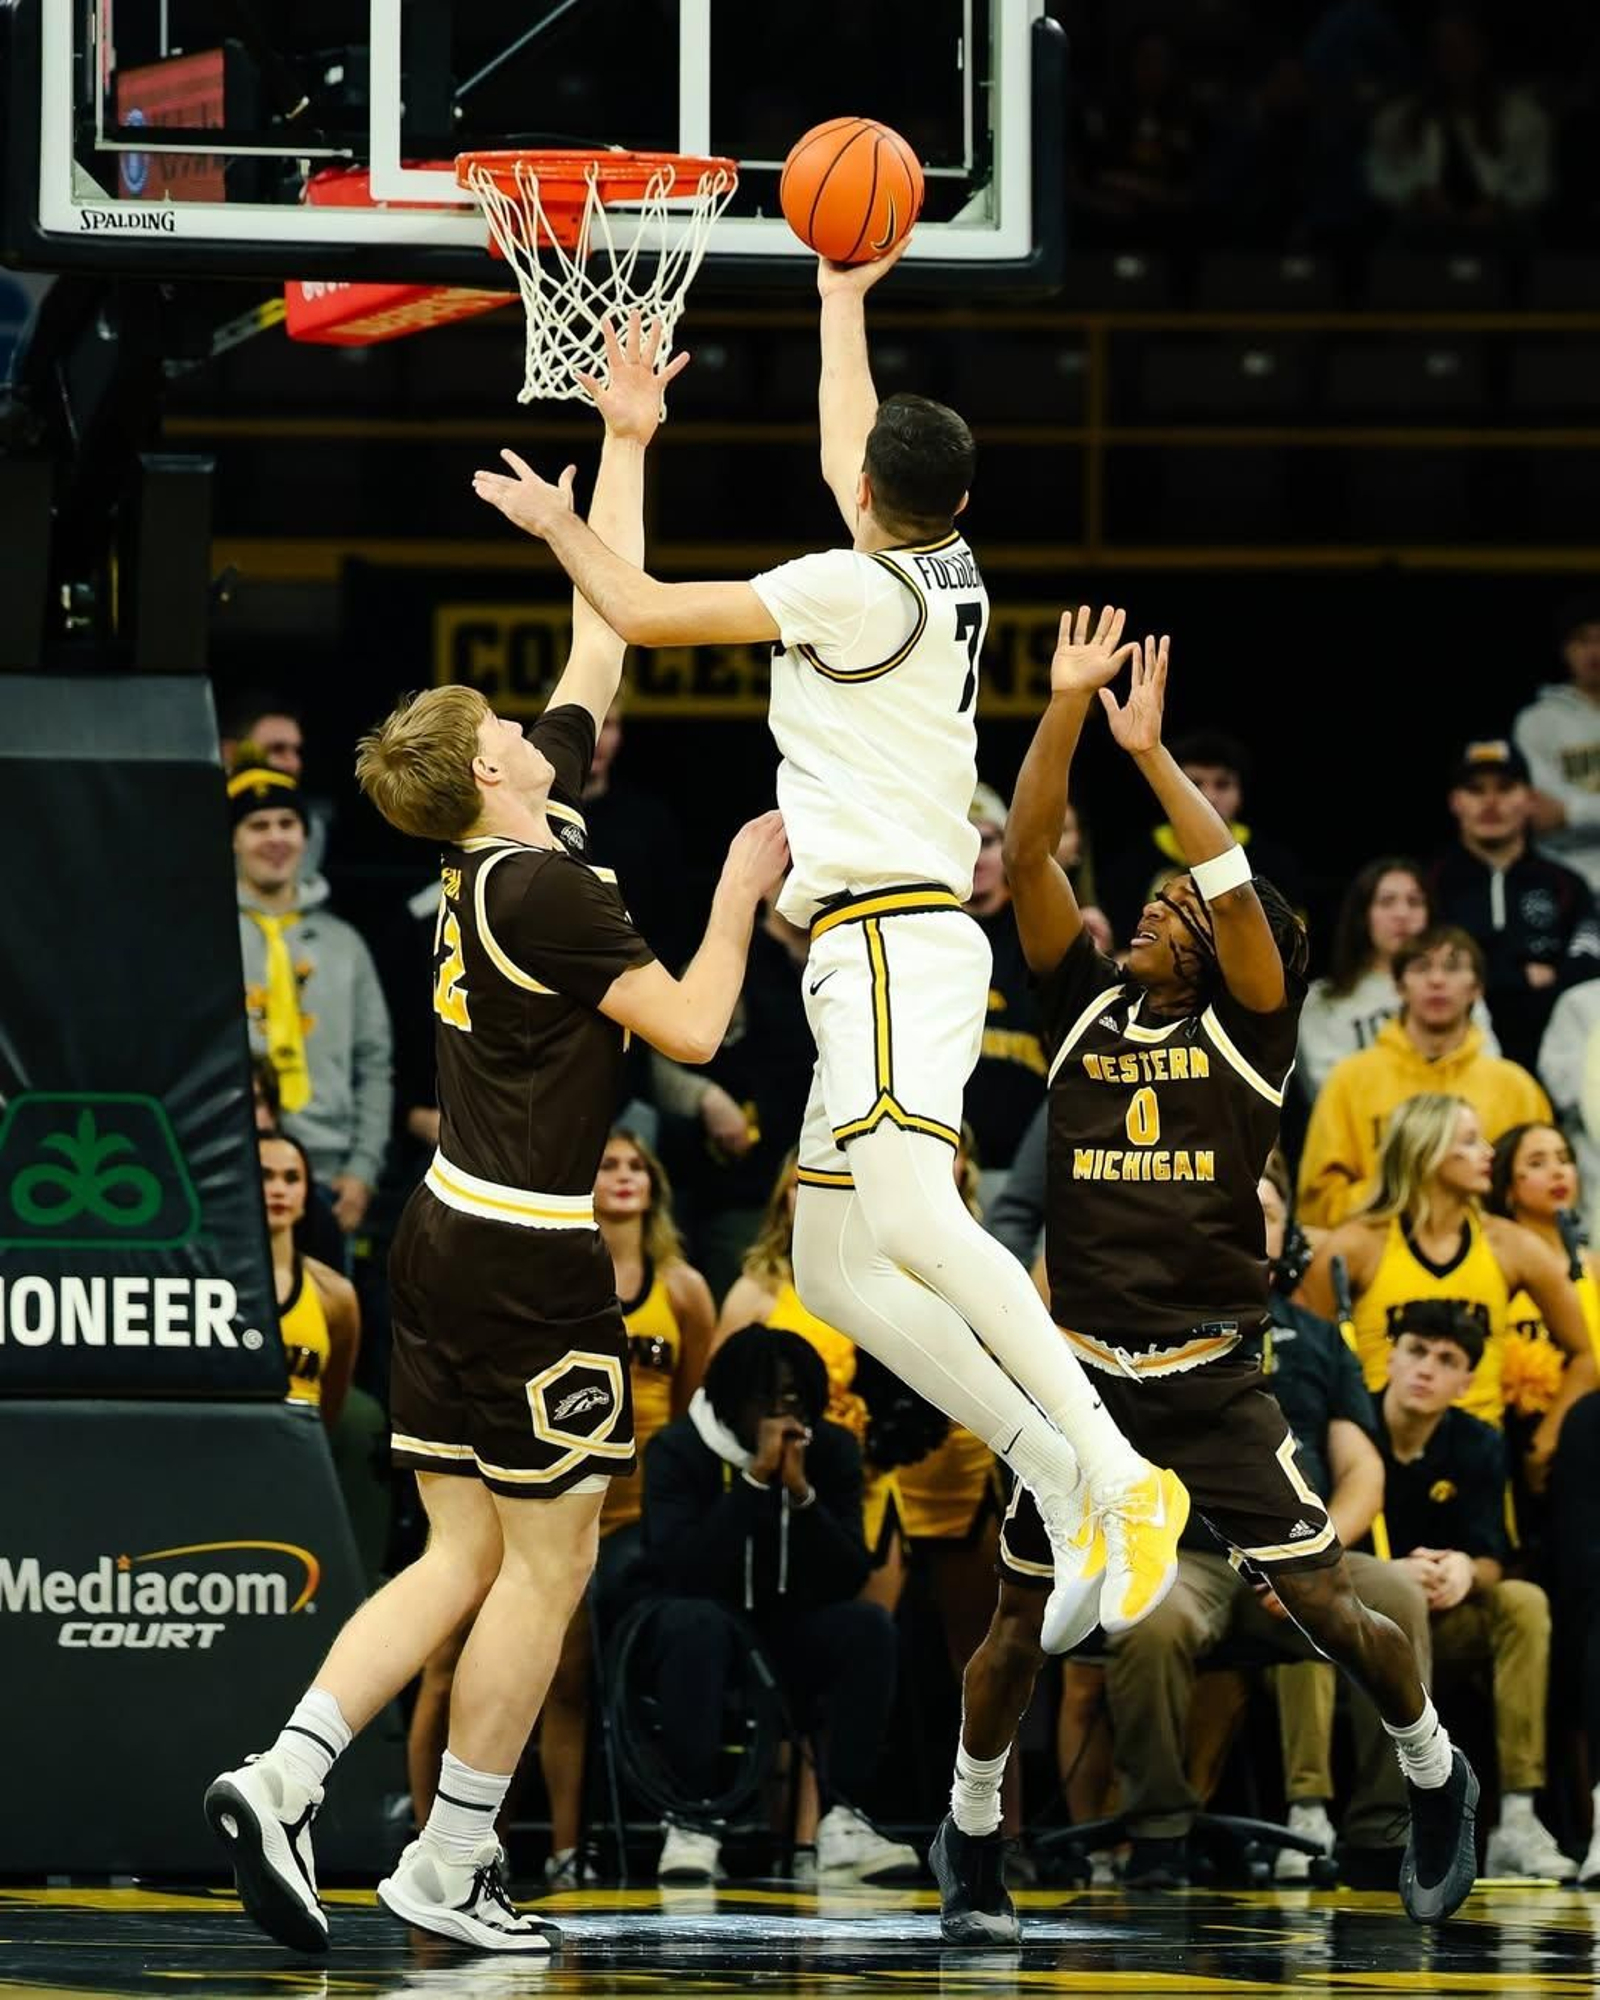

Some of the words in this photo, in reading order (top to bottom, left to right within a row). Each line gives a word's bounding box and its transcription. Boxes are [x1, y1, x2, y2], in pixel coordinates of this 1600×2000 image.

[80, 209, 176, 232] SPALDING
[954, 602, 983, 713] 7
[1082, 1047, 1210, 1084] WESTERN
[1125, 1086, 1160, 1146] 0
[1073, 1148, 1215, 1182] MICHIGAN
[0, 1555, 288, 1614] Mediacom
[58, 1622, 226, 1648] COURT
